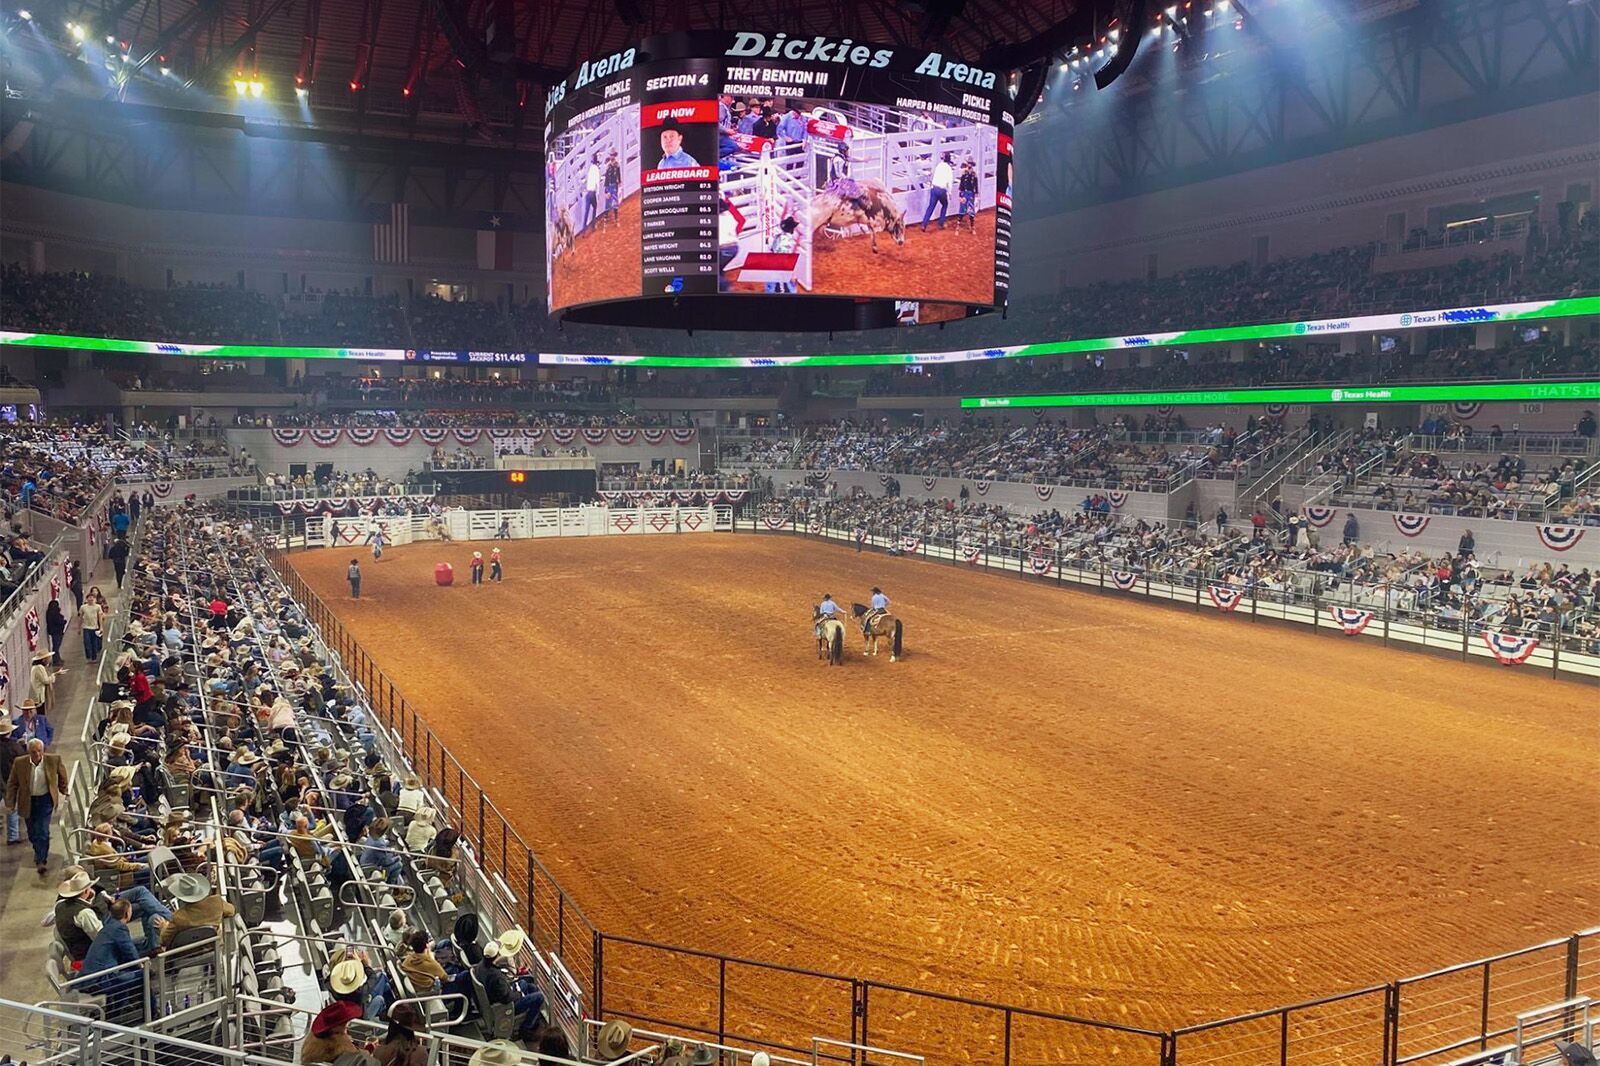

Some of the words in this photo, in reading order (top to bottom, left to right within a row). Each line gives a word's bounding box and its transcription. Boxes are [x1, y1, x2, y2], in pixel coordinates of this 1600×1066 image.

[574, 48, 636, 90] Arena
[724, 32, 894, 68] Dickies
[914, 52, 996, 90] Arena
[646, 74, 696, 91] SECTION
[698, 74, 708, 86] 4
[726, 67, 760, 80] TREY
[762, 68, 814, 84] BENTON
[815, 72, 828, 86] III
[604, 78, 632, 98] PICKLE
[724, 84, 772, 96] RICHARDS,
[774, 86, 804, 98] TEXAS
[896, 97, 926, 110] HARPER
[933, 103, 961, 116] MORGAN
[962, 108, 981, 122] RODEO
[982, 113, 990, 123] CO
[962, 93, 992, 110] PICKLE
[656, 109, 669, 120] UP
[670, 108, 696, 118] NOW
[646, 169, 710, 182] LEADERBOARD
[672, 276, 684, 293] 5
[1327, 322, 1350, 330] Health
[1528, 386, 1580, 396] THAT'S
[1523, 404, 1541, 412] 108
